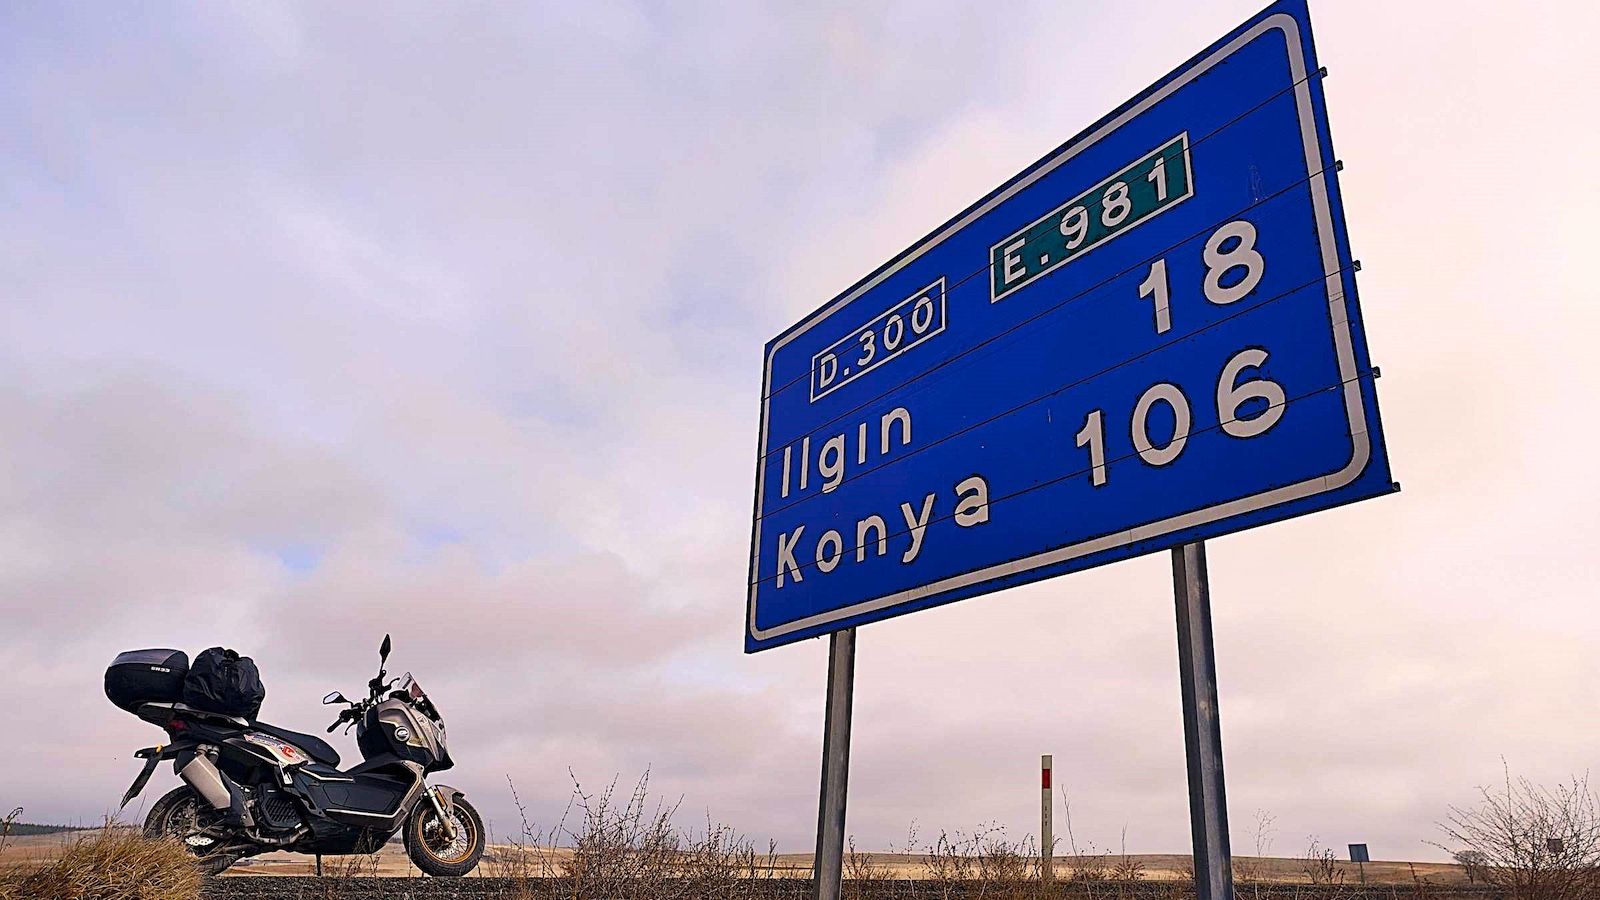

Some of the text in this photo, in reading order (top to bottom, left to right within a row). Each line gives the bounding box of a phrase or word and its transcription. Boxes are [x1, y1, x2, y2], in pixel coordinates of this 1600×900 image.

[1004, 157, 1168, 285] E.981
[781, 220, 1265, 498] Ilgın 18
[819, 296, 934, 389] D.300
[776, 348, 1286, 589] Konya 106
